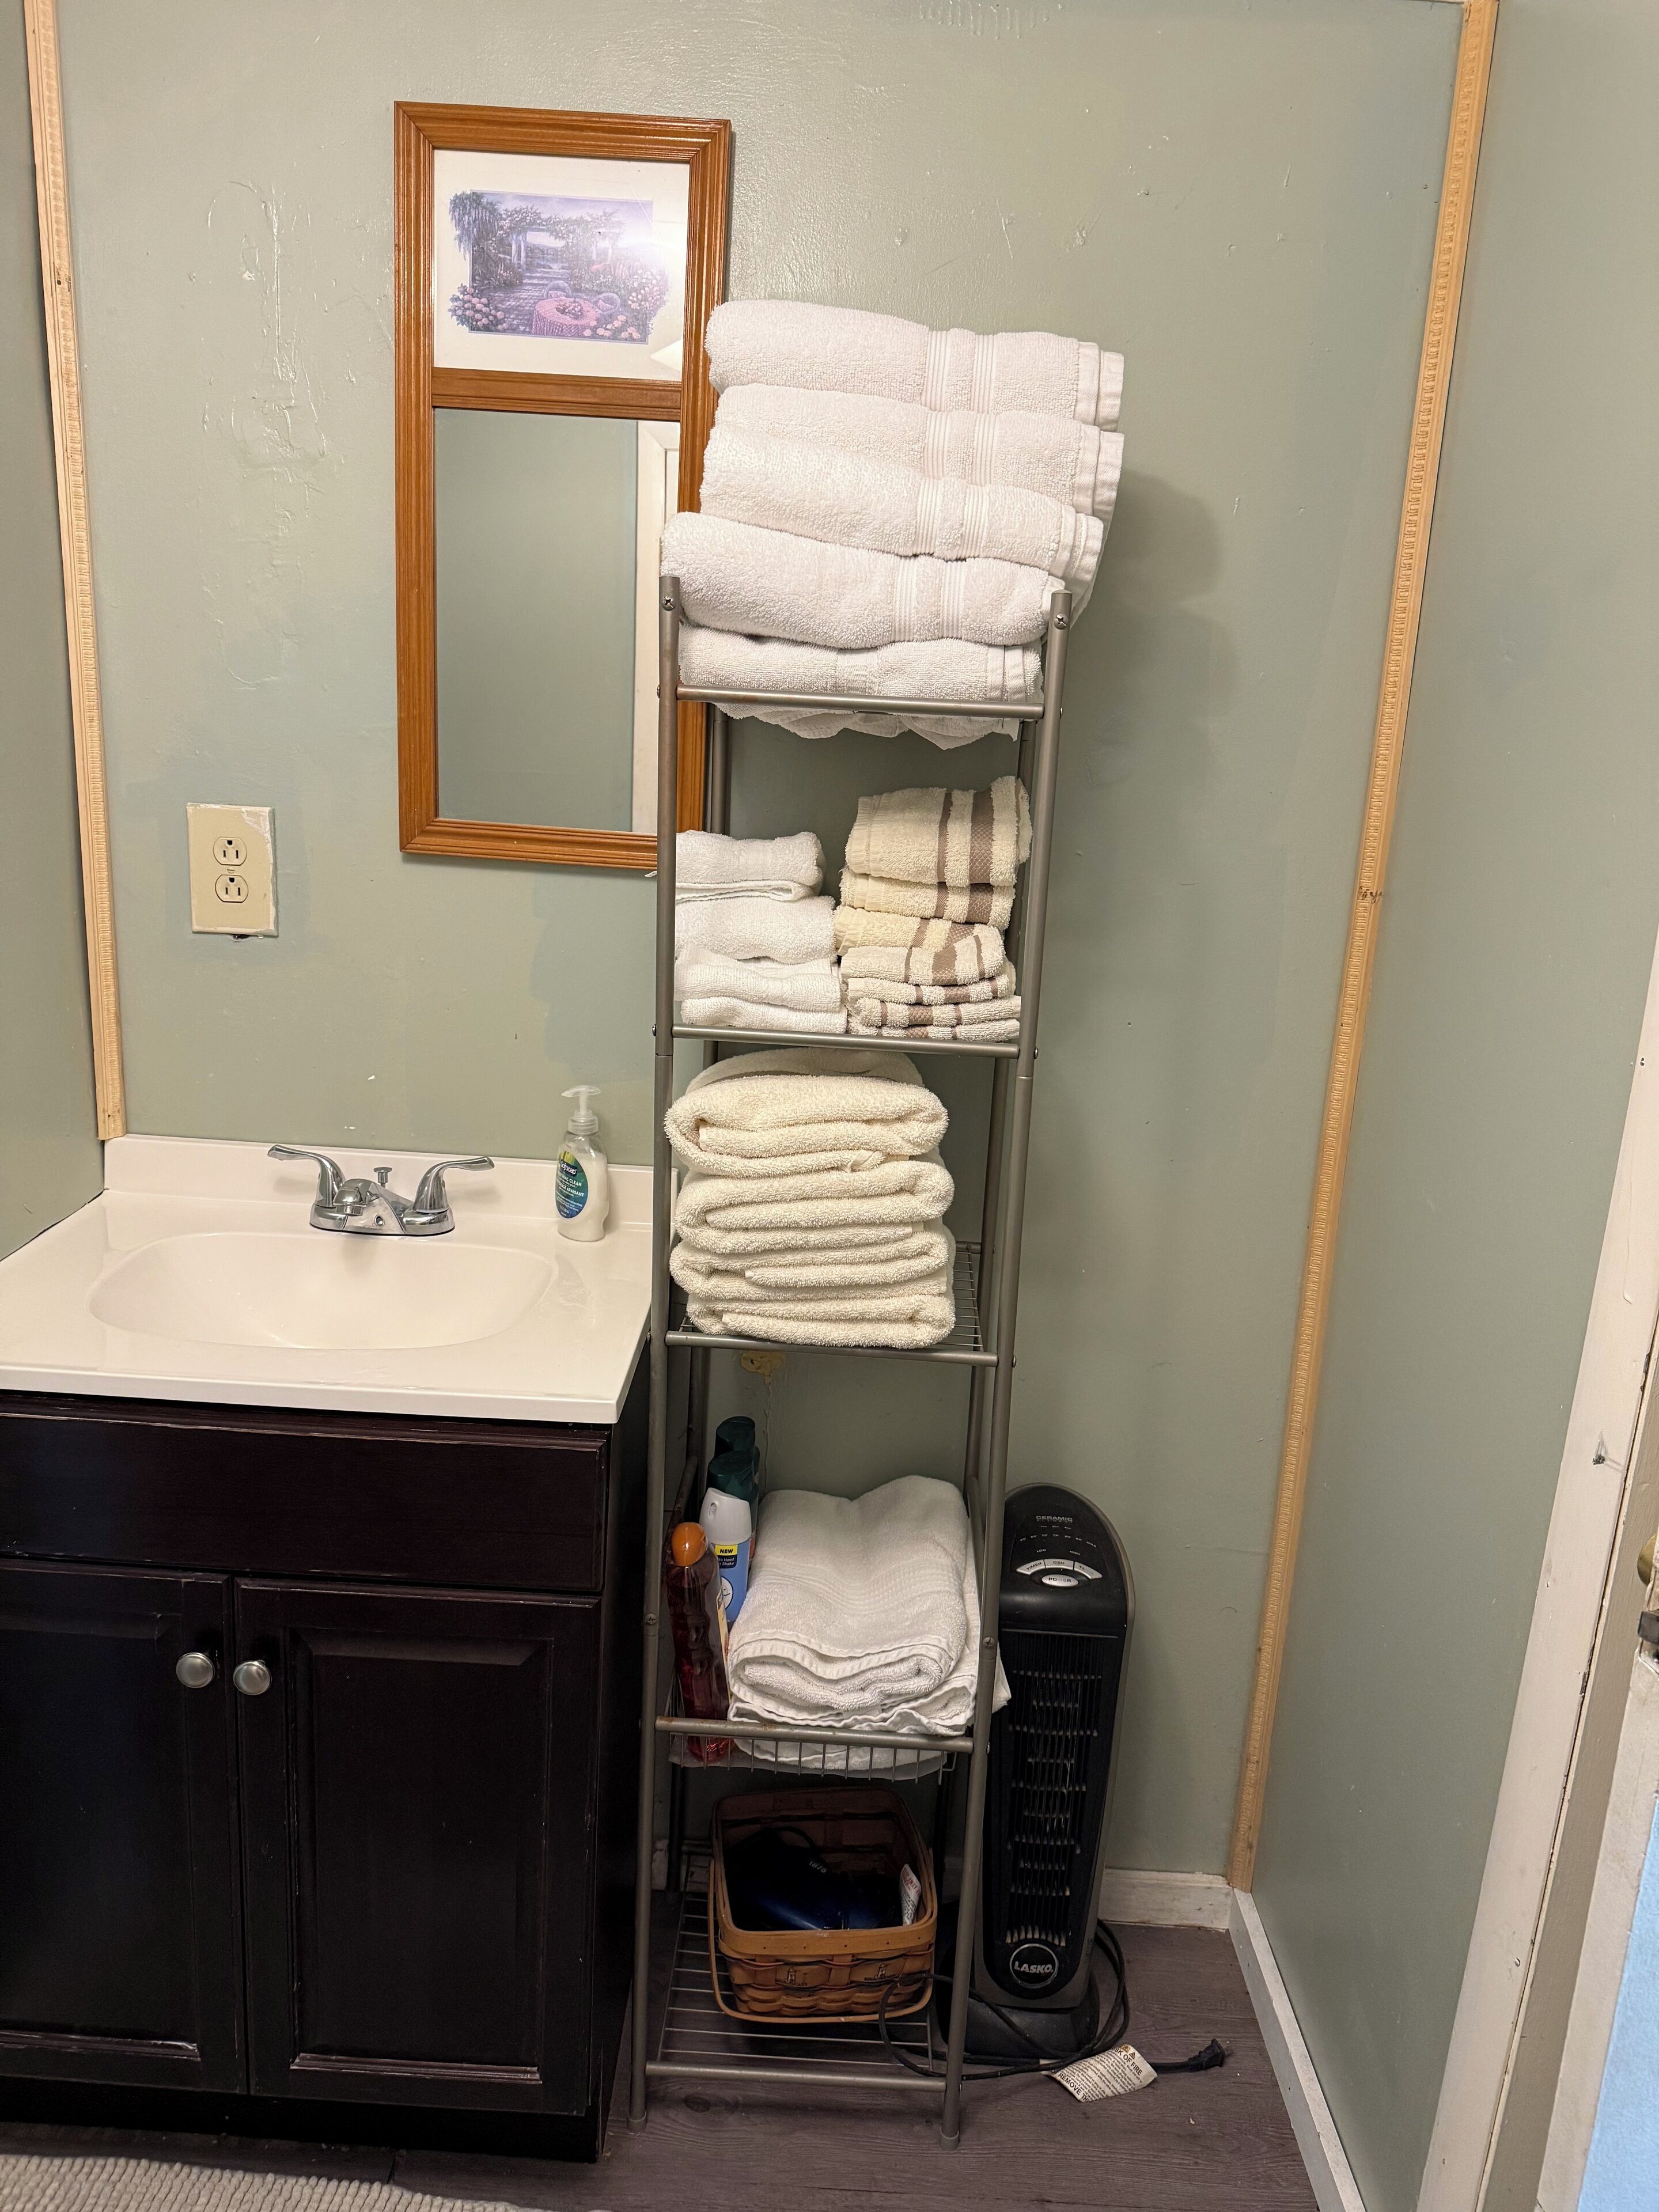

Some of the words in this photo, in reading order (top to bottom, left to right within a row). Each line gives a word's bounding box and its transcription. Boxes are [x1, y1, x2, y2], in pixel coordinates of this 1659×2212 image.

[561, 1161, 576, 1175] Softsoap
[569, 1179, 582, 1187] CLEAN
[567, 1187, 584, 1197] APAISANT
[1027, 1562, 1041, 1571] TIMER
[1014, 1961, 1053, 1974] LASKO
[1123, 2054, 1132, 2063] OF
[1130, 2061, 1143, 2076] FIRE
[1058, 2073, 1082, 2095] REMOVE
